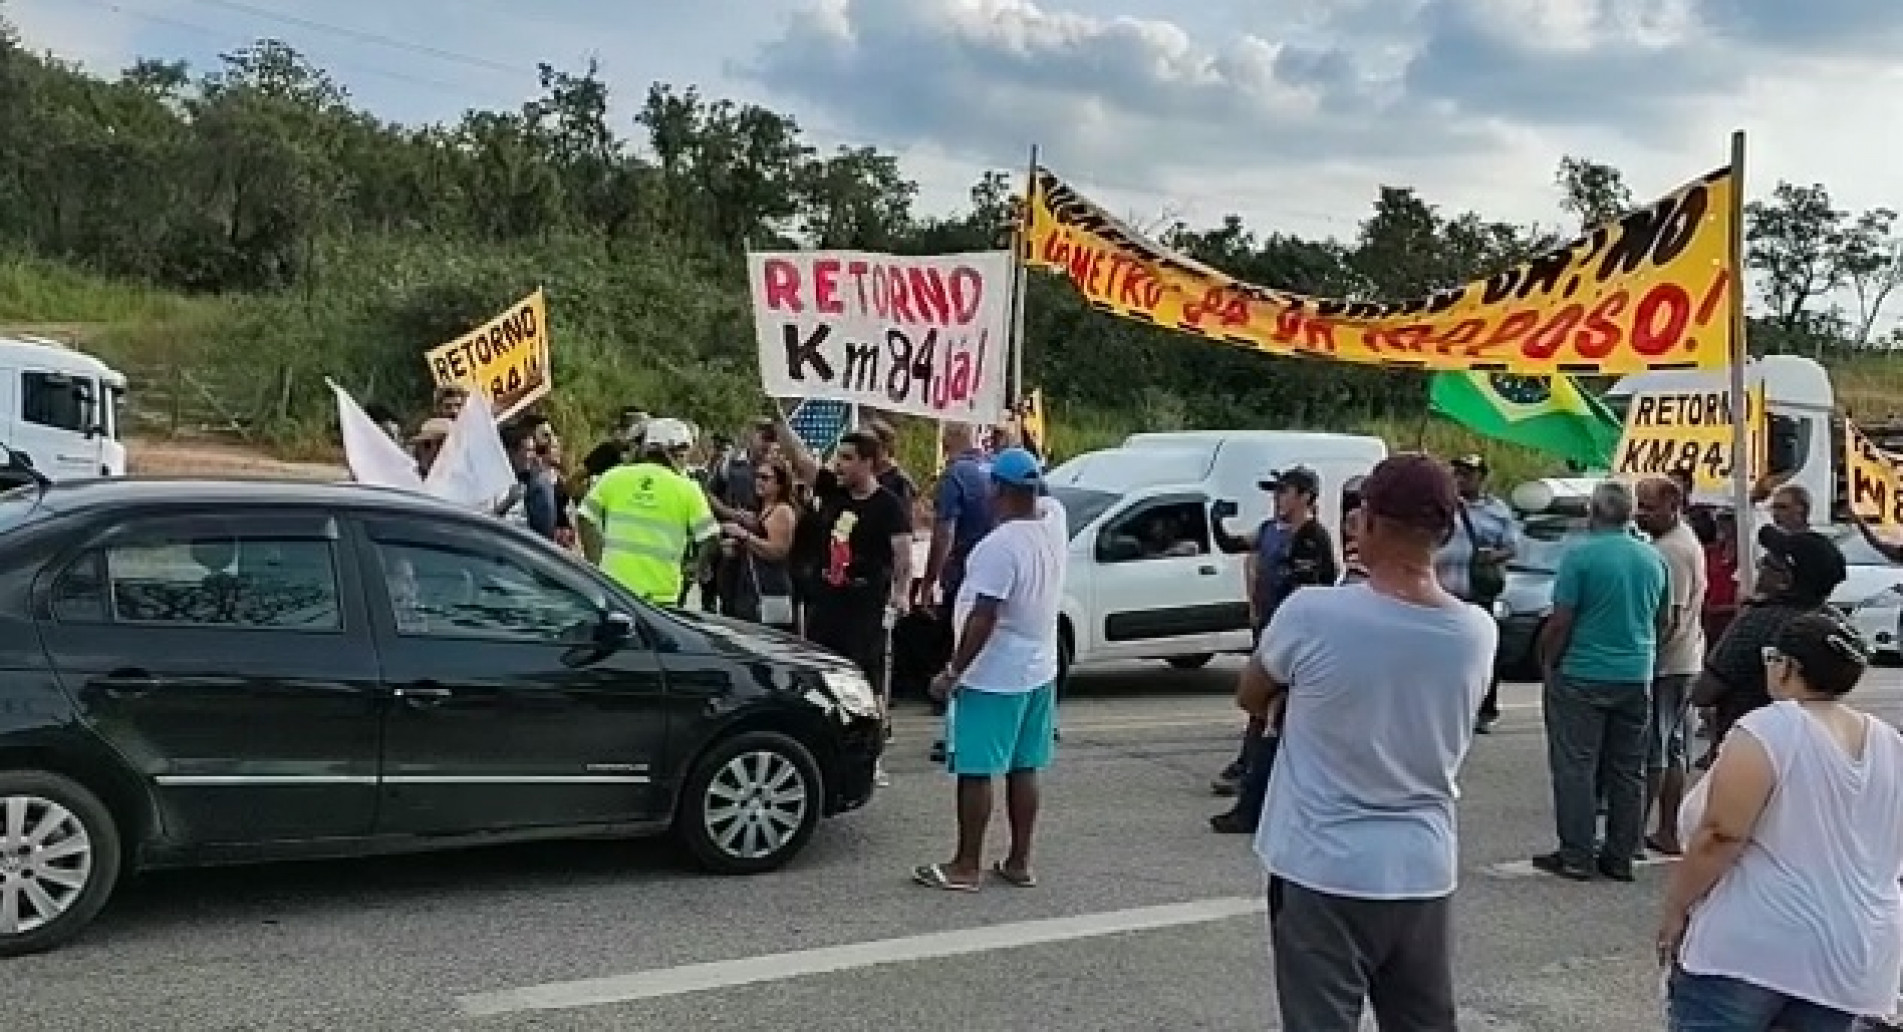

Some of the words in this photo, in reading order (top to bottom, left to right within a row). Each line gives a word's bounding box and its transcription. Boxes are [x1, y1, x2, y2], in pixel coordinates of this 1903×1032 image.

[764, 258, 983, 327] RETORNO
[433, 306, 537, 383] RETORNO
[1635, 389, 1751, 426] RETORN
[1619, 438, 1675, 473] KM
